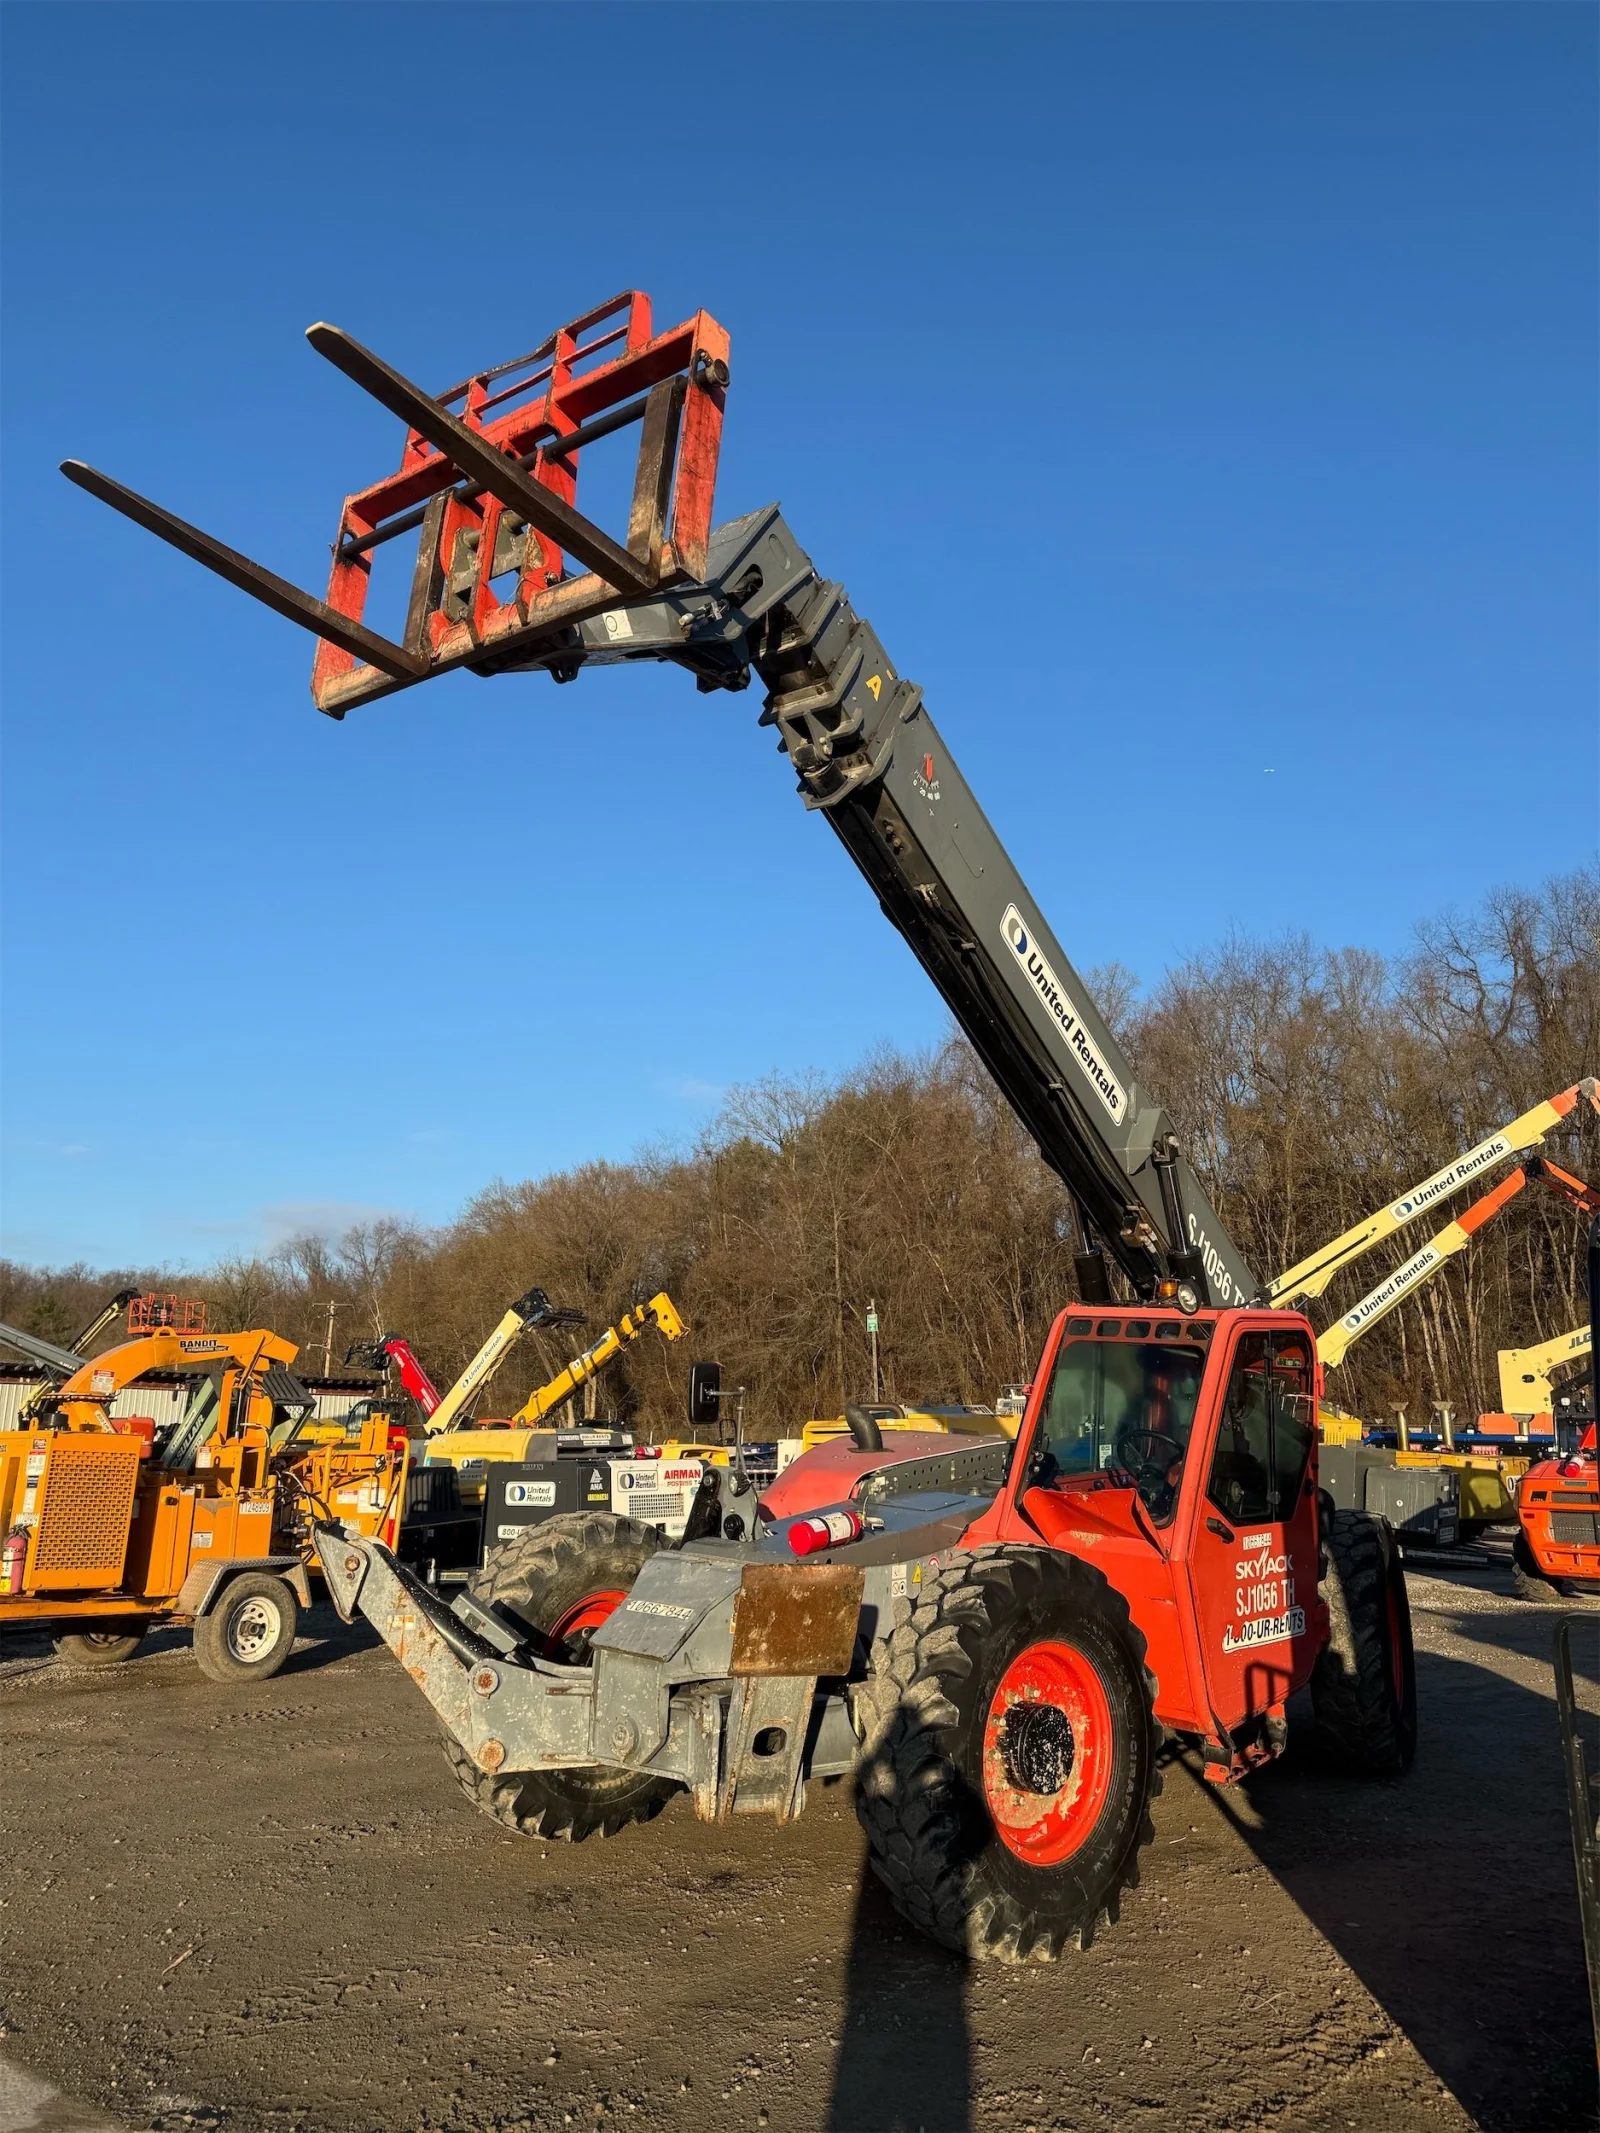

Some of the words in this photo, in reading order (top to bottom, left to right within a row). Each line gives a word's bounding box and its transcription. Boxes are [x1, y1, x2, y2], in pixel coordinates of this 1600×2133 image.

[865, 674, 882, 702] A
[1026, 952, 1075, 1033] United
[1071, 1027, 1120, 1110] Rentals
[1412, 1172, 1456, 1206] United
[1455, 1142, 1504, 1179] Rentals
[1359, 1283, 1396, 1317] United
[1394, 1252, 1435, 1288] Rentals
[179, 1339, 219, 1348] BANDIT
[176, 1414, 206, 1458] SULLAIR
[635, 1472, 656, 1482] United
[635, 1480, 657, 1490] Rentals
[664, 1469, 701, 1480] AIRMAN
[526, 1494, 552, 1503] Rentals
[527, 1485, 551, 1494] United
[1235, 1547, 1294, 1581] SKYJACK
[1236, 1581, 1277, 1617] SJ1056
[1281, 1578, 1295, 1607] TH
[627, 1600, 693, 1620] 10667844
